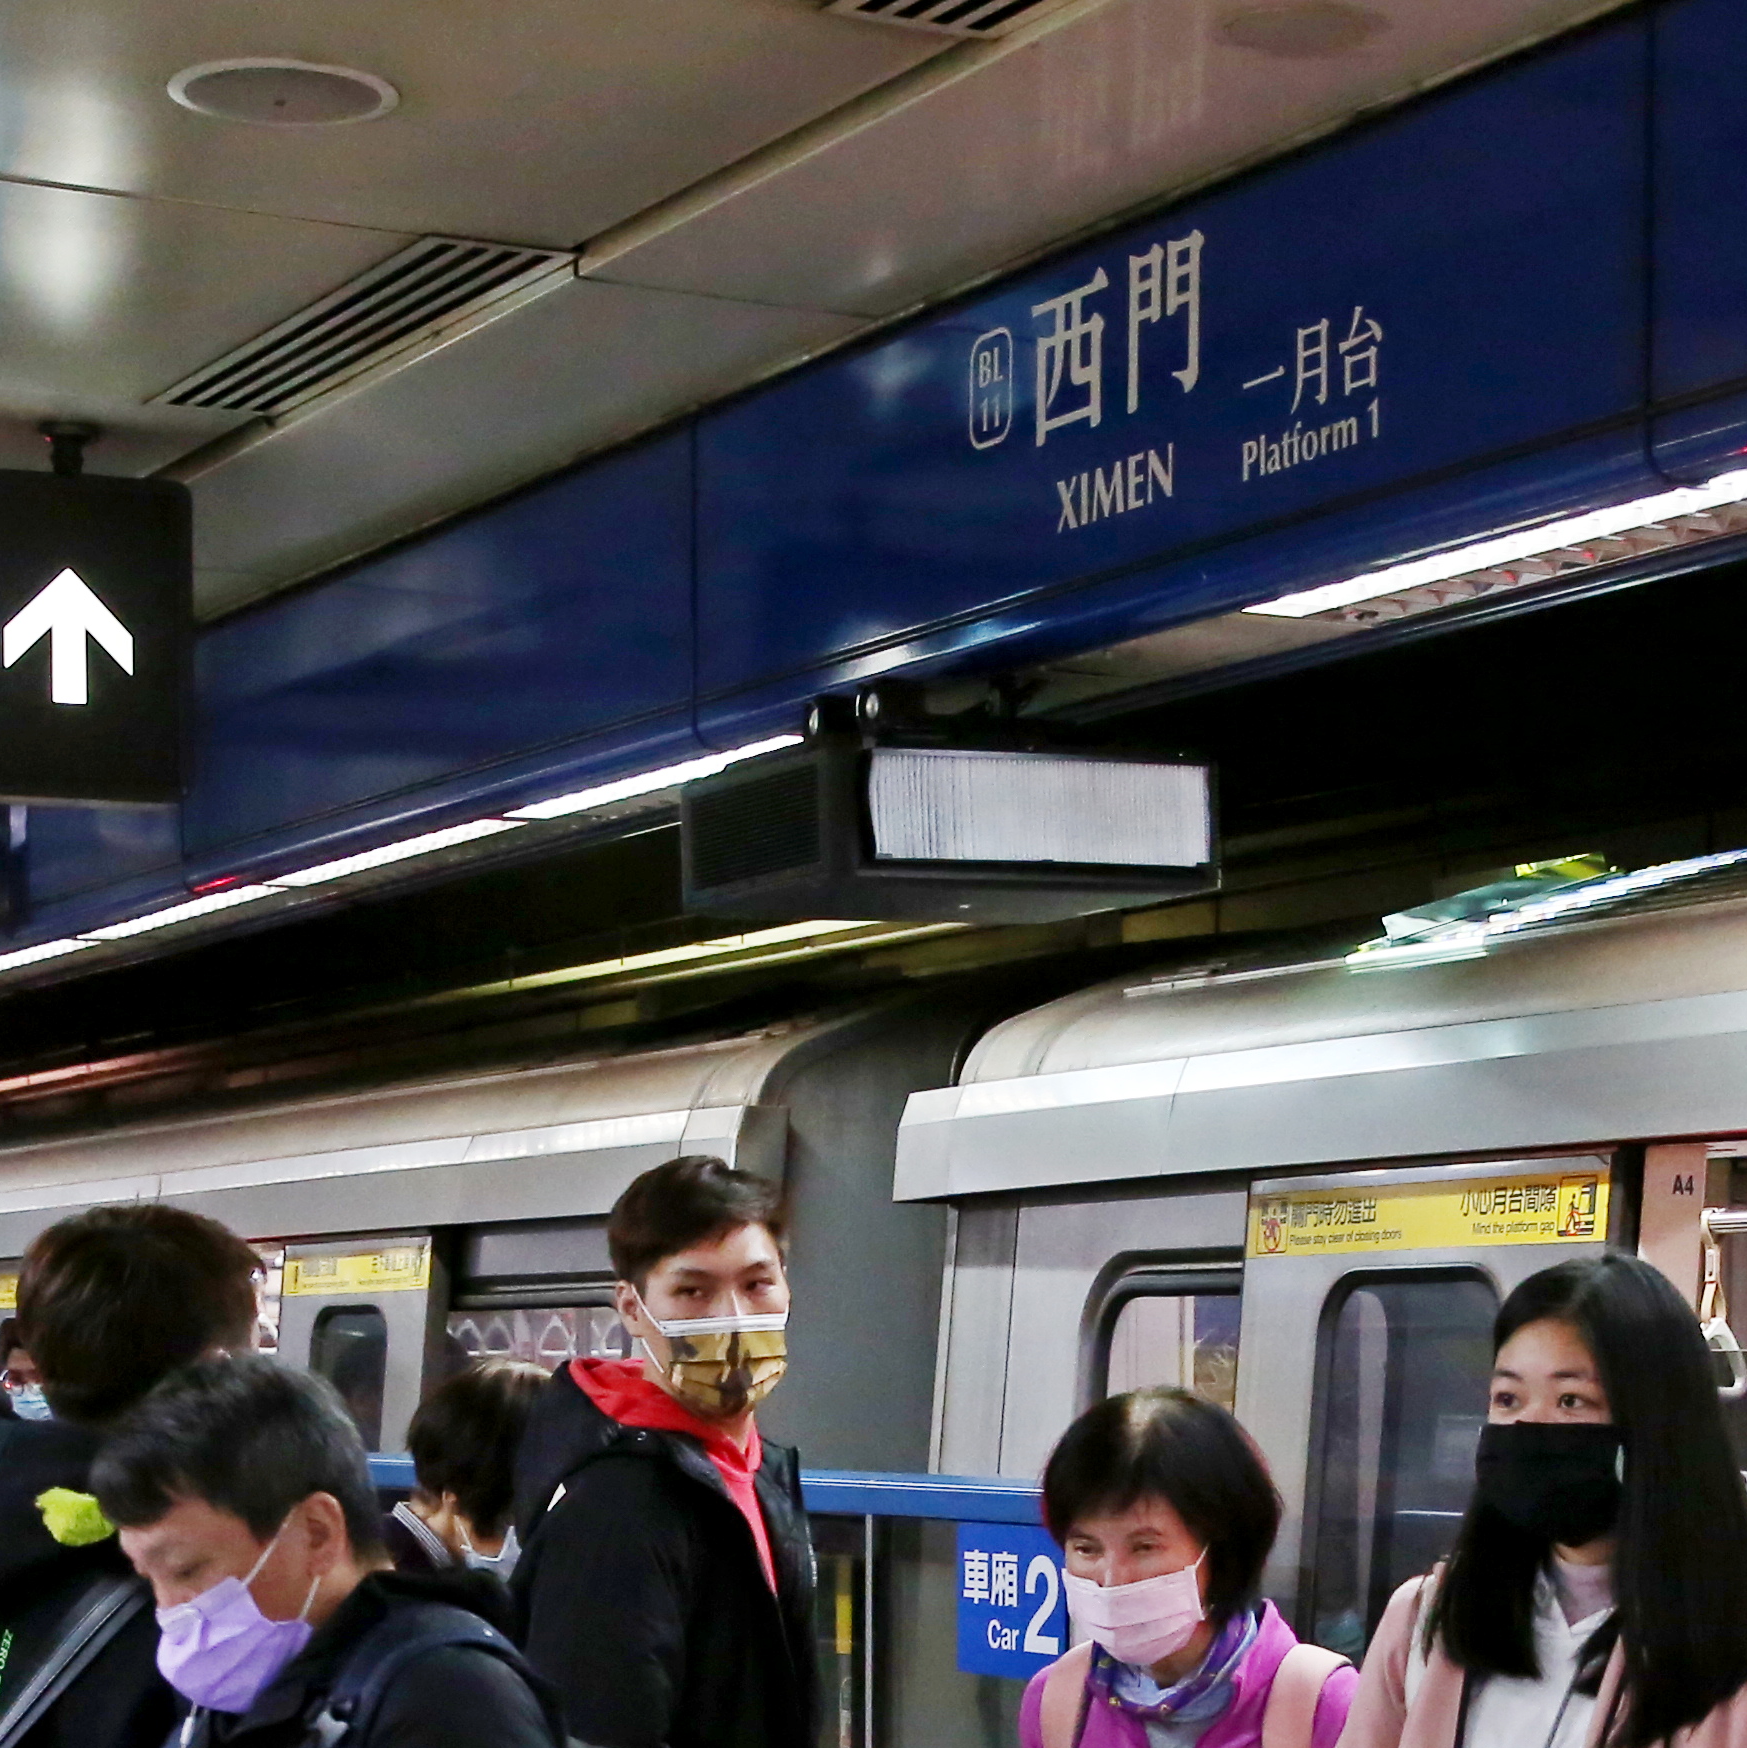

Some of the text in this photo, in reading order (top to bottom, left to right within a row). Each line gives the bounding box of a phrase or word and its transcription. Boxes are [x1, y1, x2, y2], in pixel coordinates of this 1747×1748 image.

[978, 346, 1004, 389] BL
[1031, 228, 1206, 448] 西門
[1242, 305, 1384, 415] 一月台
[979, 395, 1001, 433] 11
[1242, 397, 1380, 483] Platform 1
[1056, 442, 1174, 534] XIMEN
[1672, 1174, 1694, 1196] A4
[962, 1548, 1019, 1608] 車廂
[1023, 1554, 1060, 1657] 2
[987, 1619, 1020, 1652] Car
